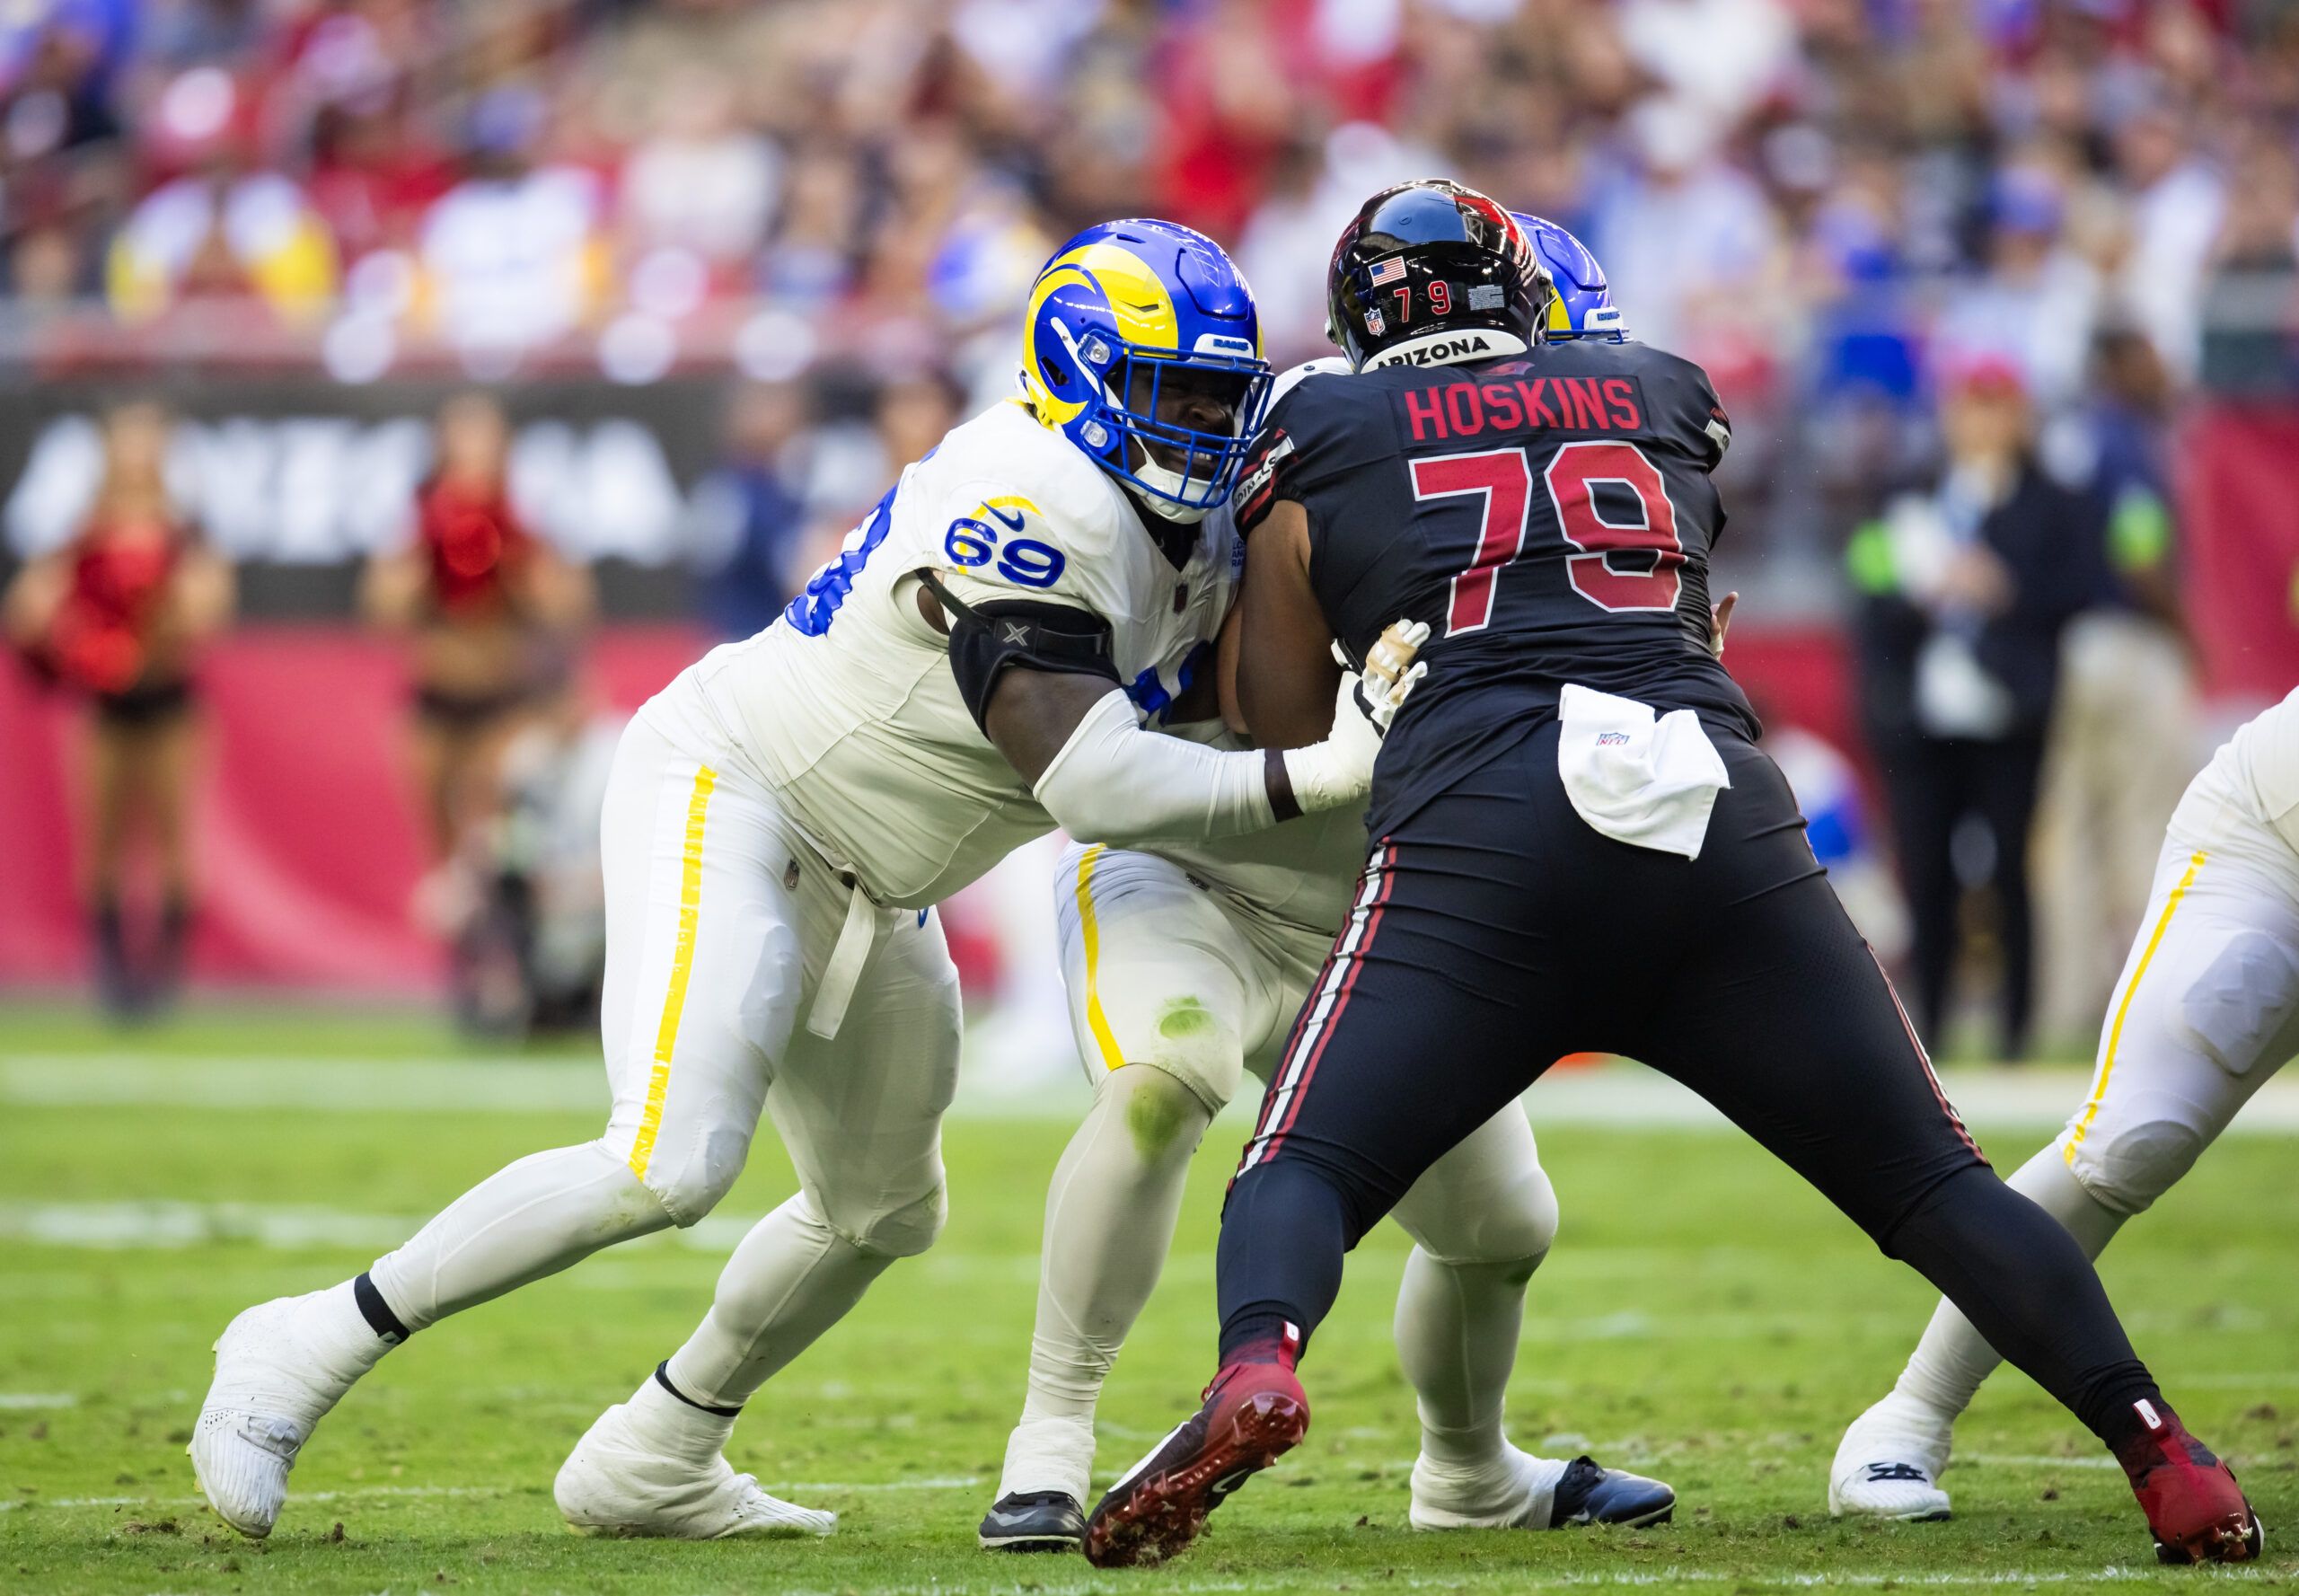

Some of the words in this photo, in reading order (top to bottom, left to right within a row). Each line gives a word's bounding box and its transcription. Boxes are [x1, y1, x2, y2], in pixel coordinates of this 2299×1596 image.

[1405, 377, 1642, 440] HOSKINS
[945, 517, 1066, 587] 69
[1408, 439, 1688, 639] 79
